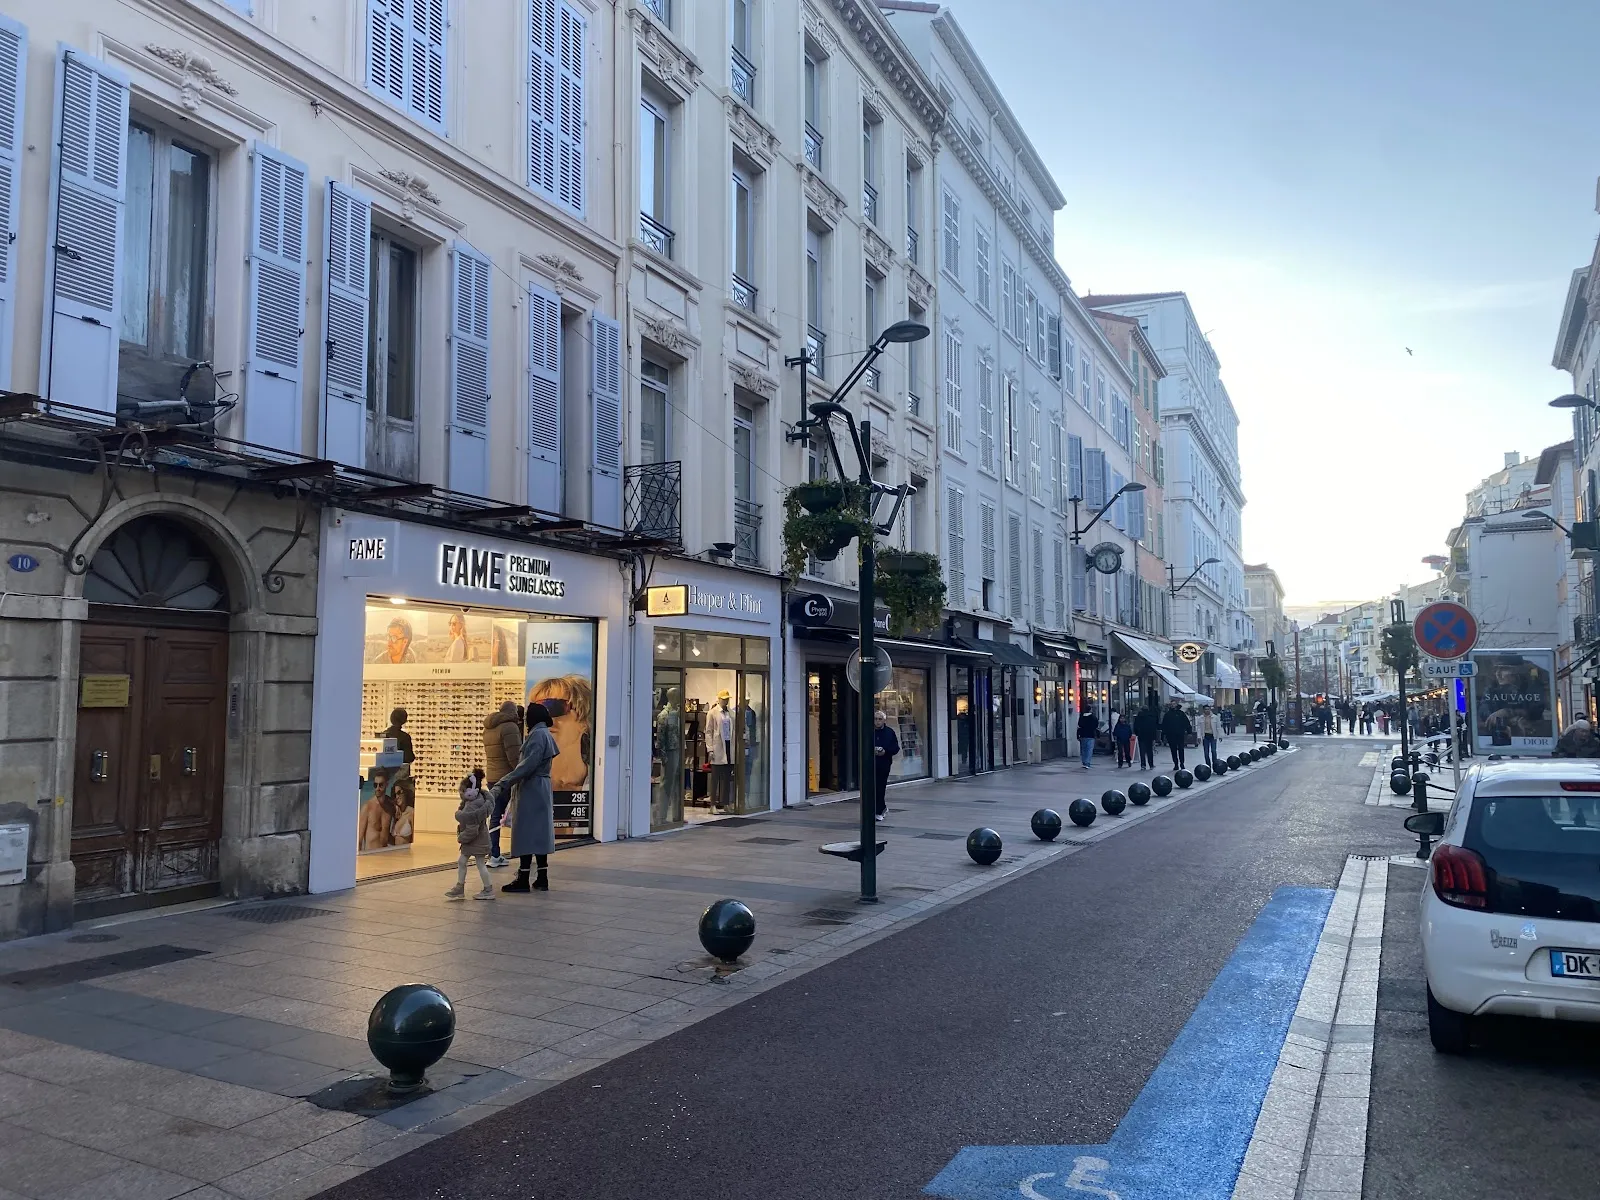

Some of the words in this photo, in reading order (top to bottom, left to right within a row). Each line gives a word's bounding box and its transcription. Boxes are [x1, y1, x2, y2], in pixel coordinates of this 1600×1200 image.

[349, 538, 385, 560] FAME
[17, 557, 31, 570] 10
[441, 544, 505, 590] FAME
[510, 555, 551, 577] PREMIUM
[509, 575, 565, 598] SUNGLASSES
[688, 585, 725, 612] Harper
[728, 592, 737, 610] &
[740, 593, 763, 614] Flint
[532, 642, 560, 654] FAME
[1427, 665, 1457, 675] SAUF
[1485, 693, 1541, 702] SAUVAGE
[1523, 738, 1549, 746] DIOR
[1565, 954, 1600, 977] DK-
